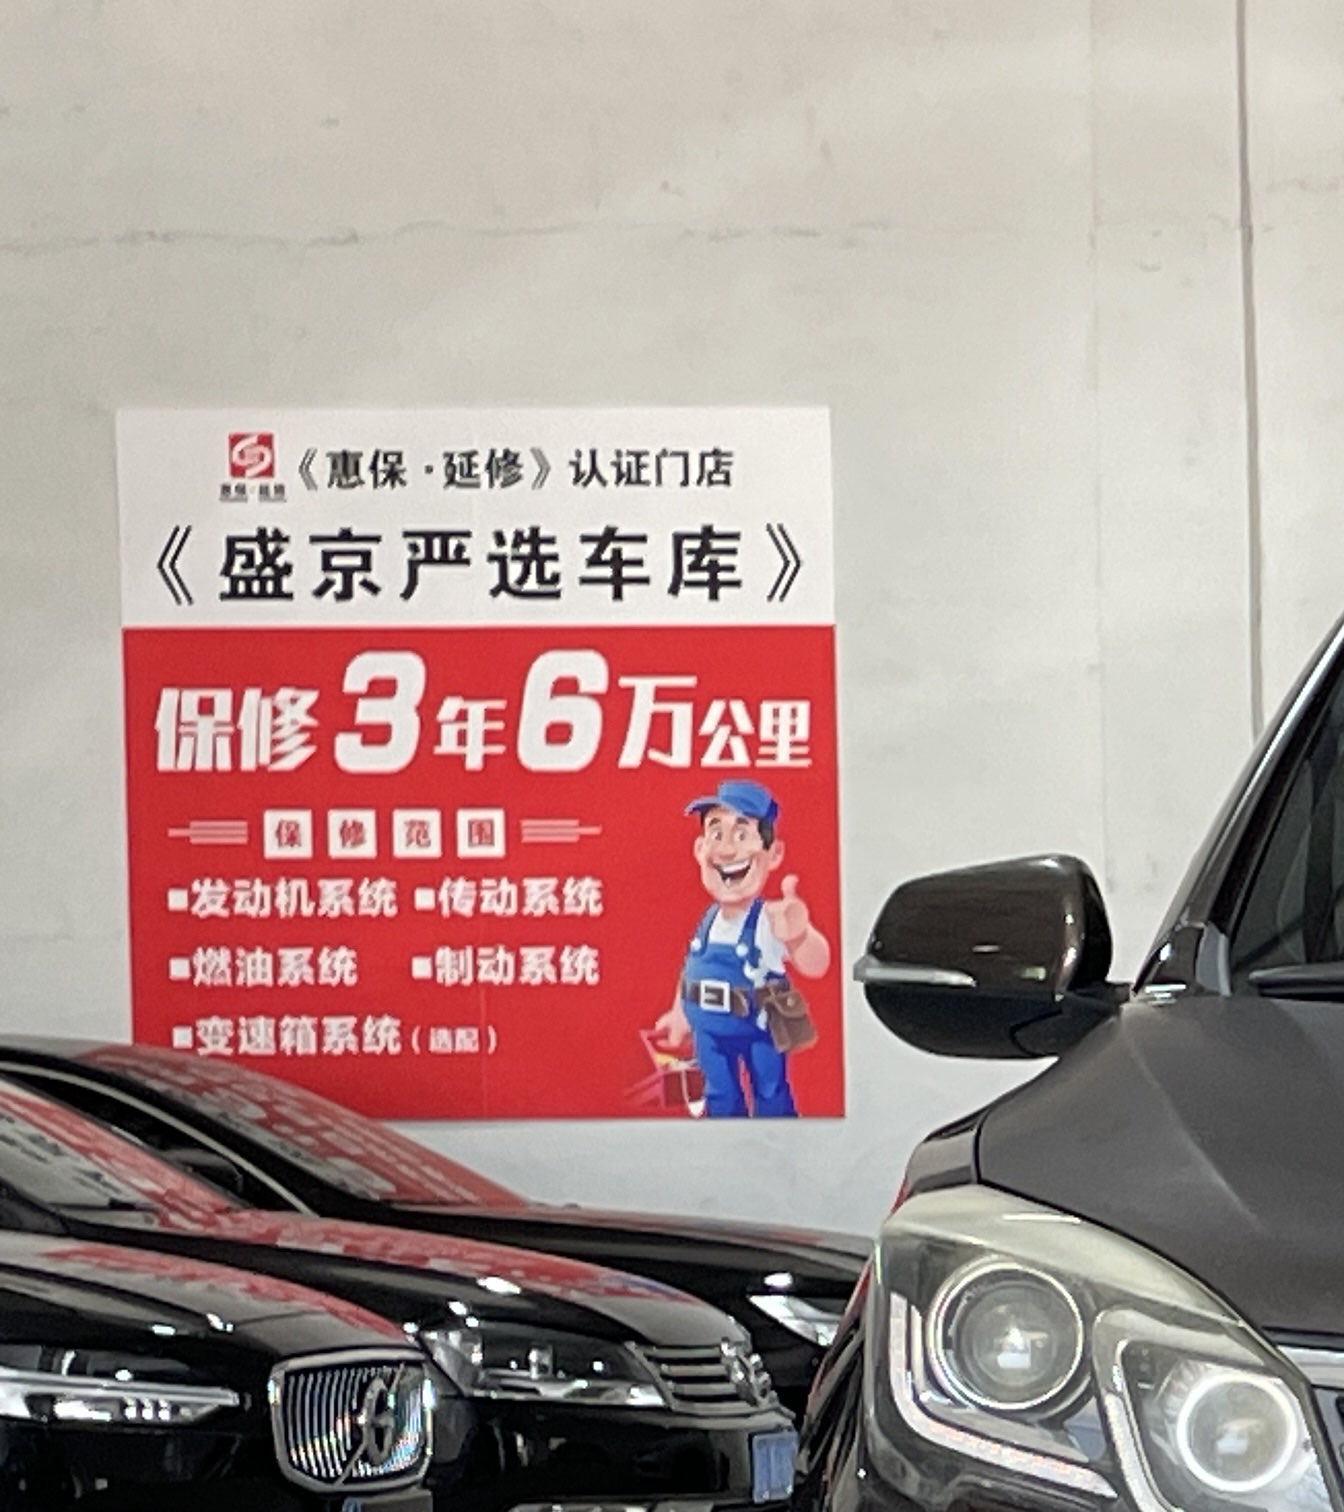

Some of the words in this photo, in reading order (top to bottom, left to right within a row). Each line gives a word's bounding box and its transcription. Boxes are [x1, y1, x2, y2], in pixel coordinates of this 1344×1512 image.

[156, 523, 804, 606] 《盛京严选车库》
[153, 648, 814, 775] 保修3年6万公里
